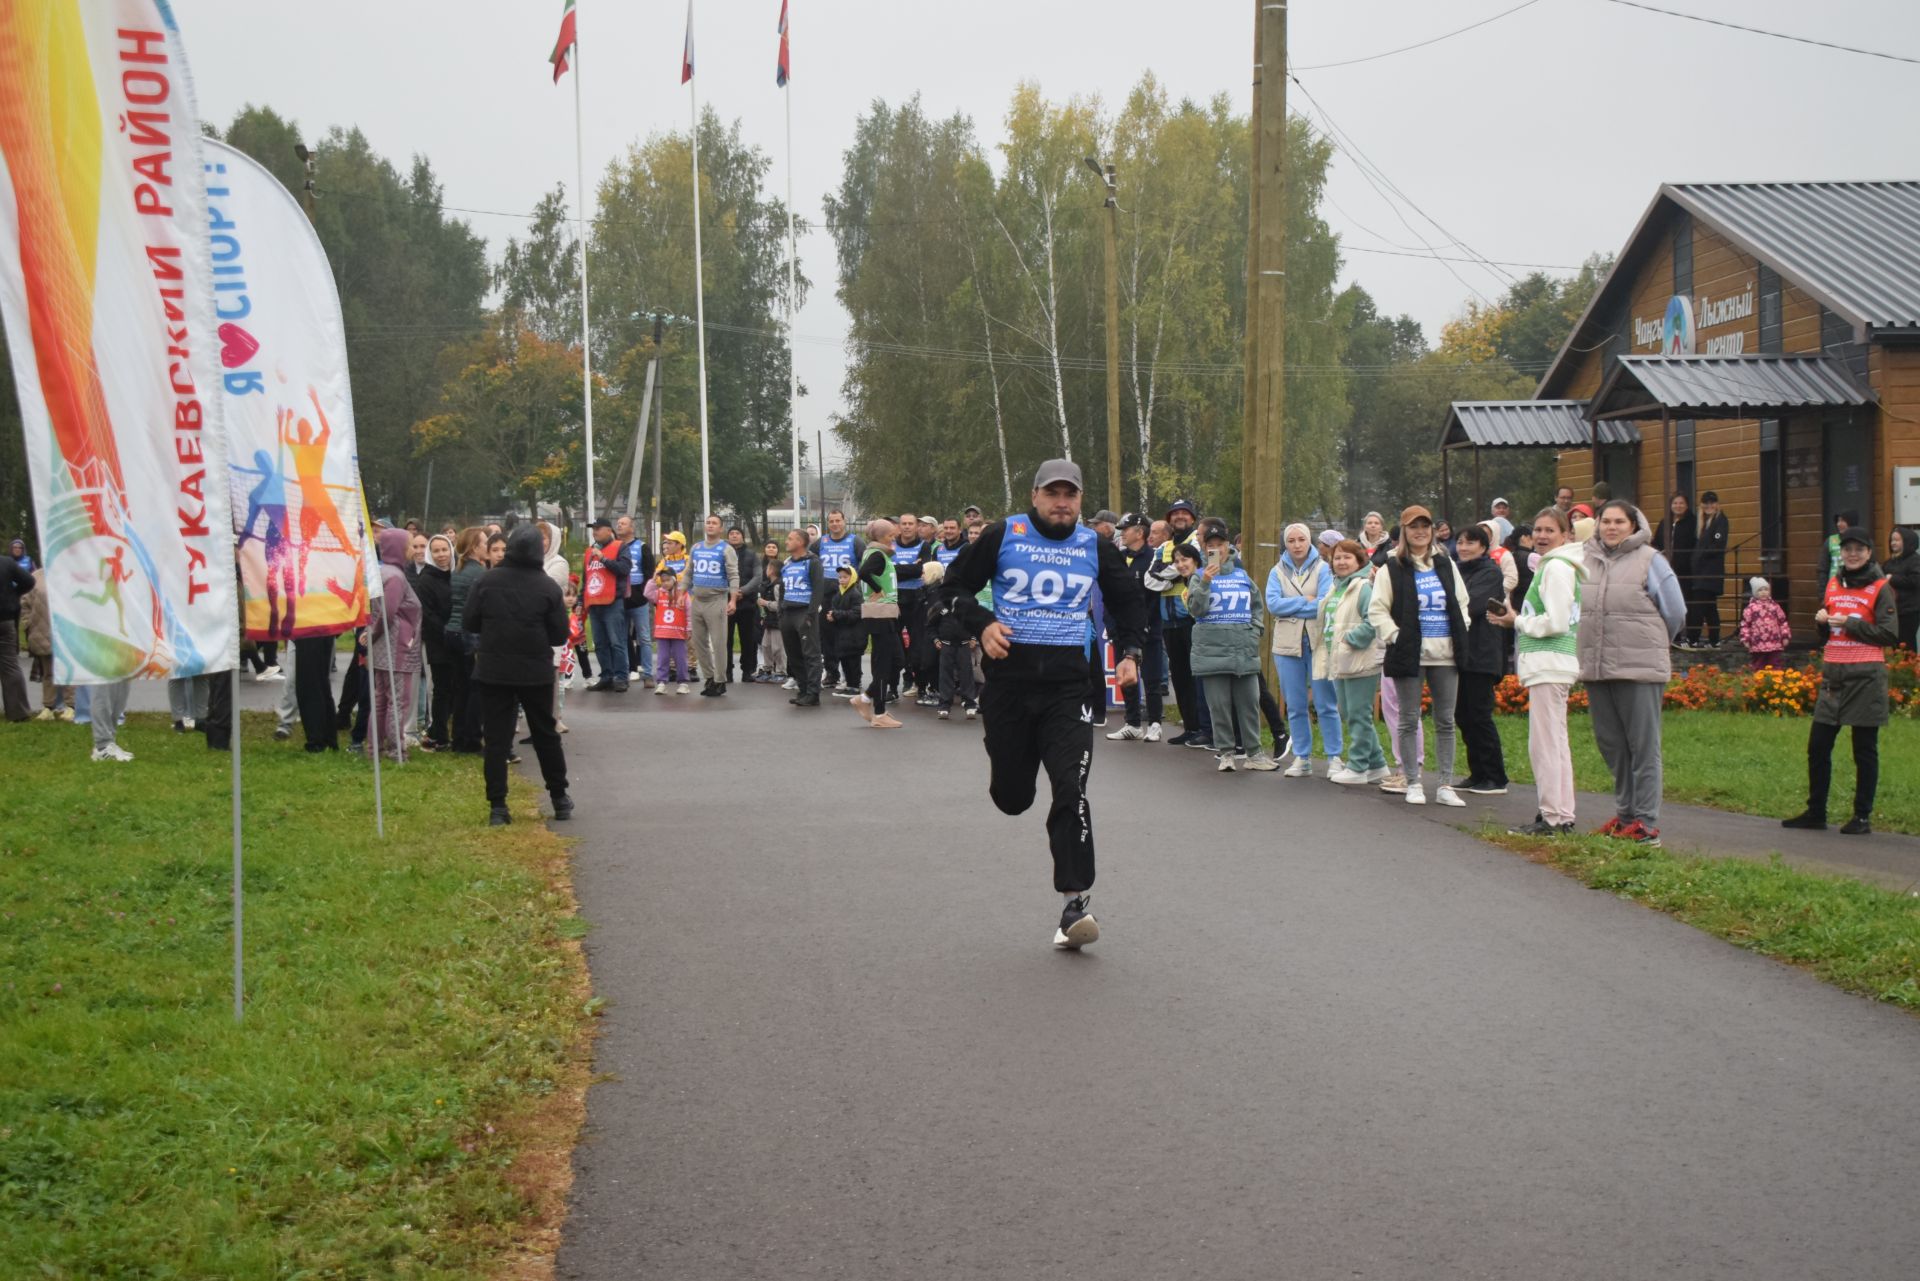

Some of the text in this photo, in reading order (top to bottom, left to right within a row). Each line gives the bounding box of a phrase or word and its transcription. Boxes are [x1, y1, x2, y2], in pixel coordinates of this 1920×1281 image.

[117, 28, 174, 217] РАЙОН
[1698, 281, 1753, 329] Лыжный
[223, 371, 265, 396] Я
[1014, 543, 1087, 558] ТУКАЕВСКИЙ
[1031, 552, 1071, 566] РАЙОН
[1002, 568, 1093, 608] 207
[1208, 591, 1251, 612] 277
[663, 609, 675, 624] 8
